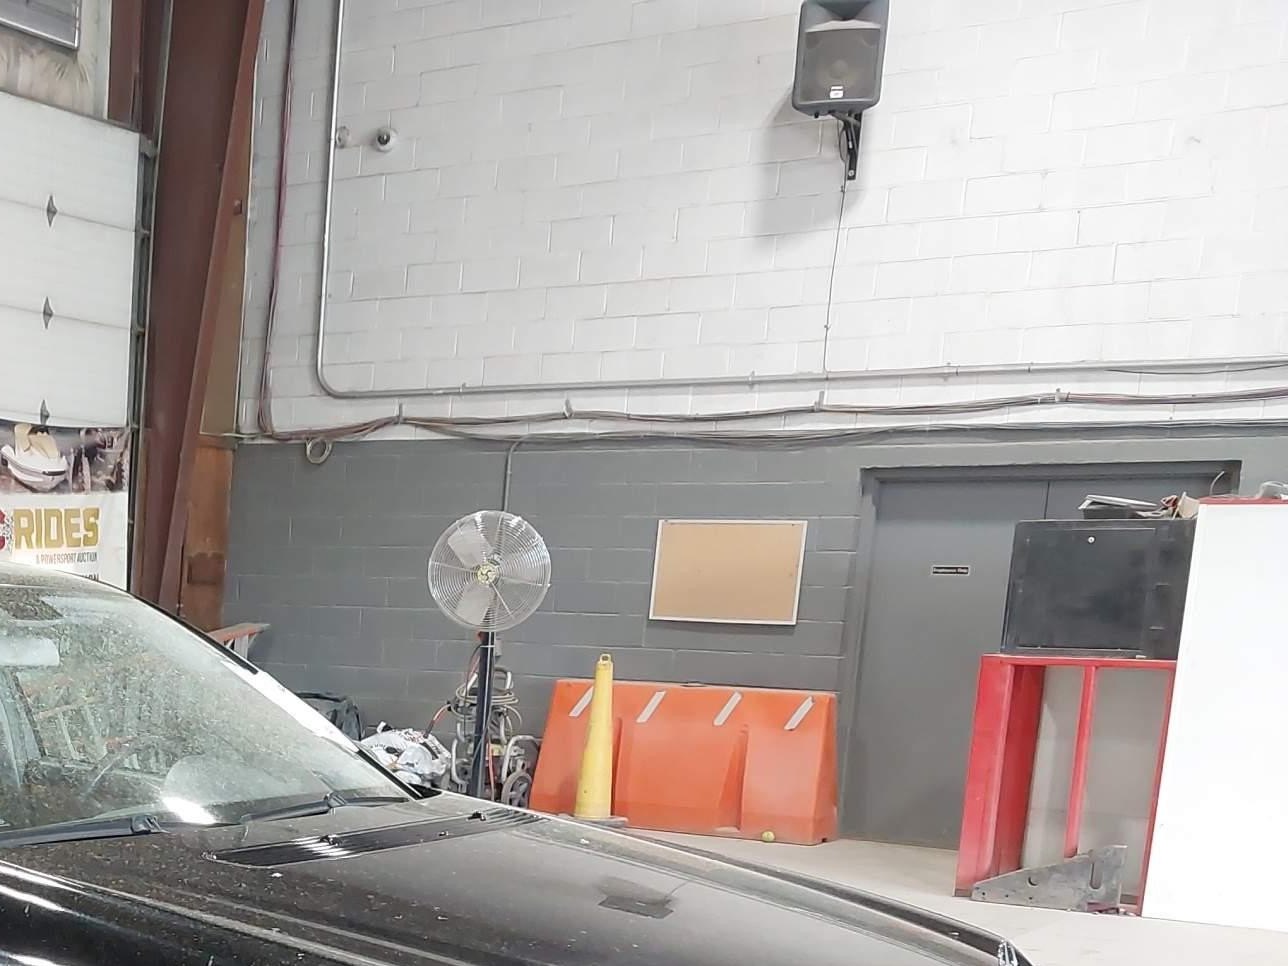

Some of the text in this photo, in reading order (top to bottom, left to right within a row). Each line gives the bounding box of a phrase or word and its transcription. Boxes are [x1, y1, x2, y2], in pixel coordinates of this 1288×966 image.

[13, 507, 100, 550] RIDES
[40, 552, 76, 565] POWERSPORT
[77, 551, 98, 563] AUCTION
